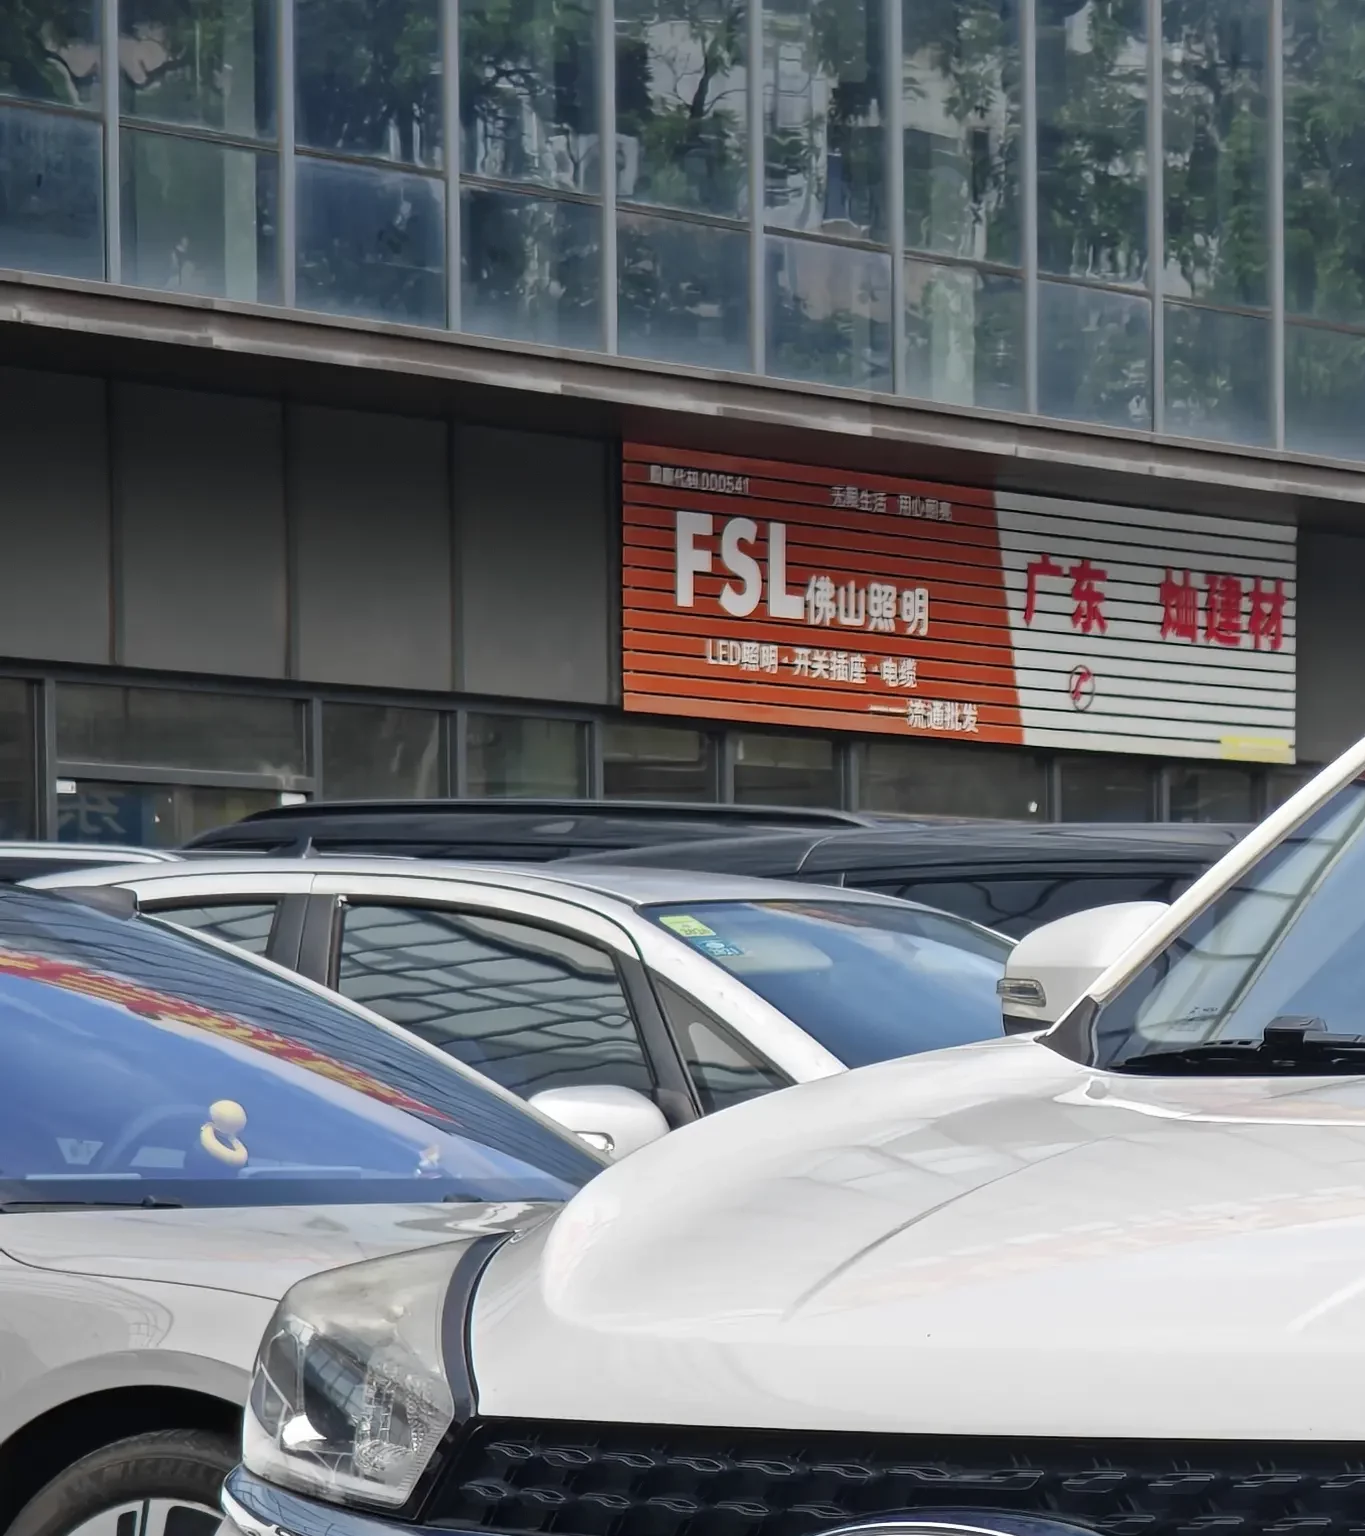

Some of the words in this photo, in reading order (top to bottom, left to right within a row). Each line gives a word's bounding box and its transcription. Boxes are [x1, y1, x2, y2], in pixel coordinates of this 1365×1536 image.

[676, 510, 804, 618] FSL
[1023, 552, 1108, 634] 广东
[805, 574, 929, 637] 佛山照明
